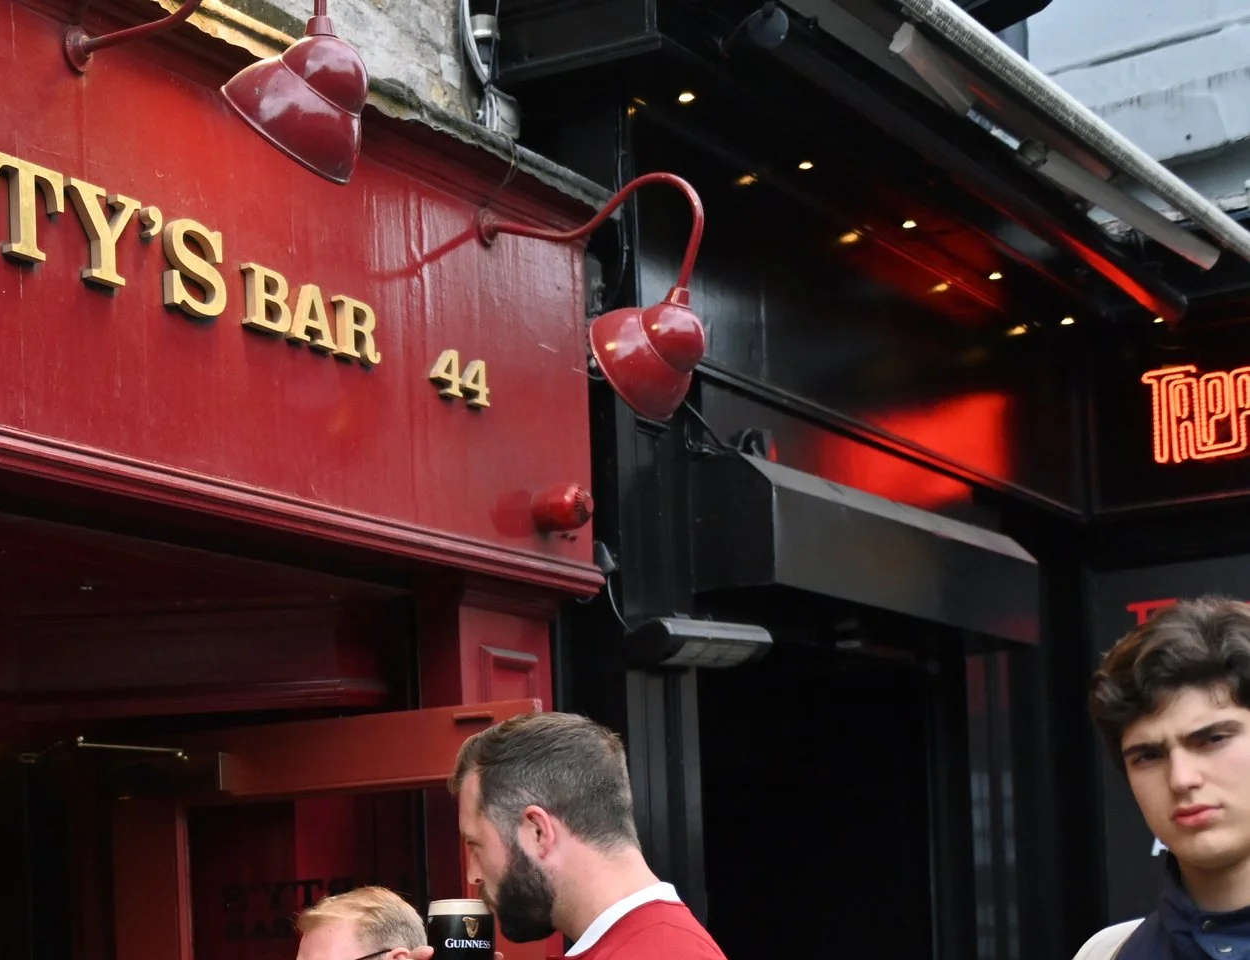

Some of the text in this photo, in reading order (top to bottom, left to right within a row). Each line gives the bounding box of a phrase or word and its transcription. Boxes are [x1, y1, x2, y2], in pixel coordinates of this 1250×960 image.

[239, 262, 382, 366] BAR
[428, 348, 492, 410] 44
[444, 937, 491, 949] GUINNESS
